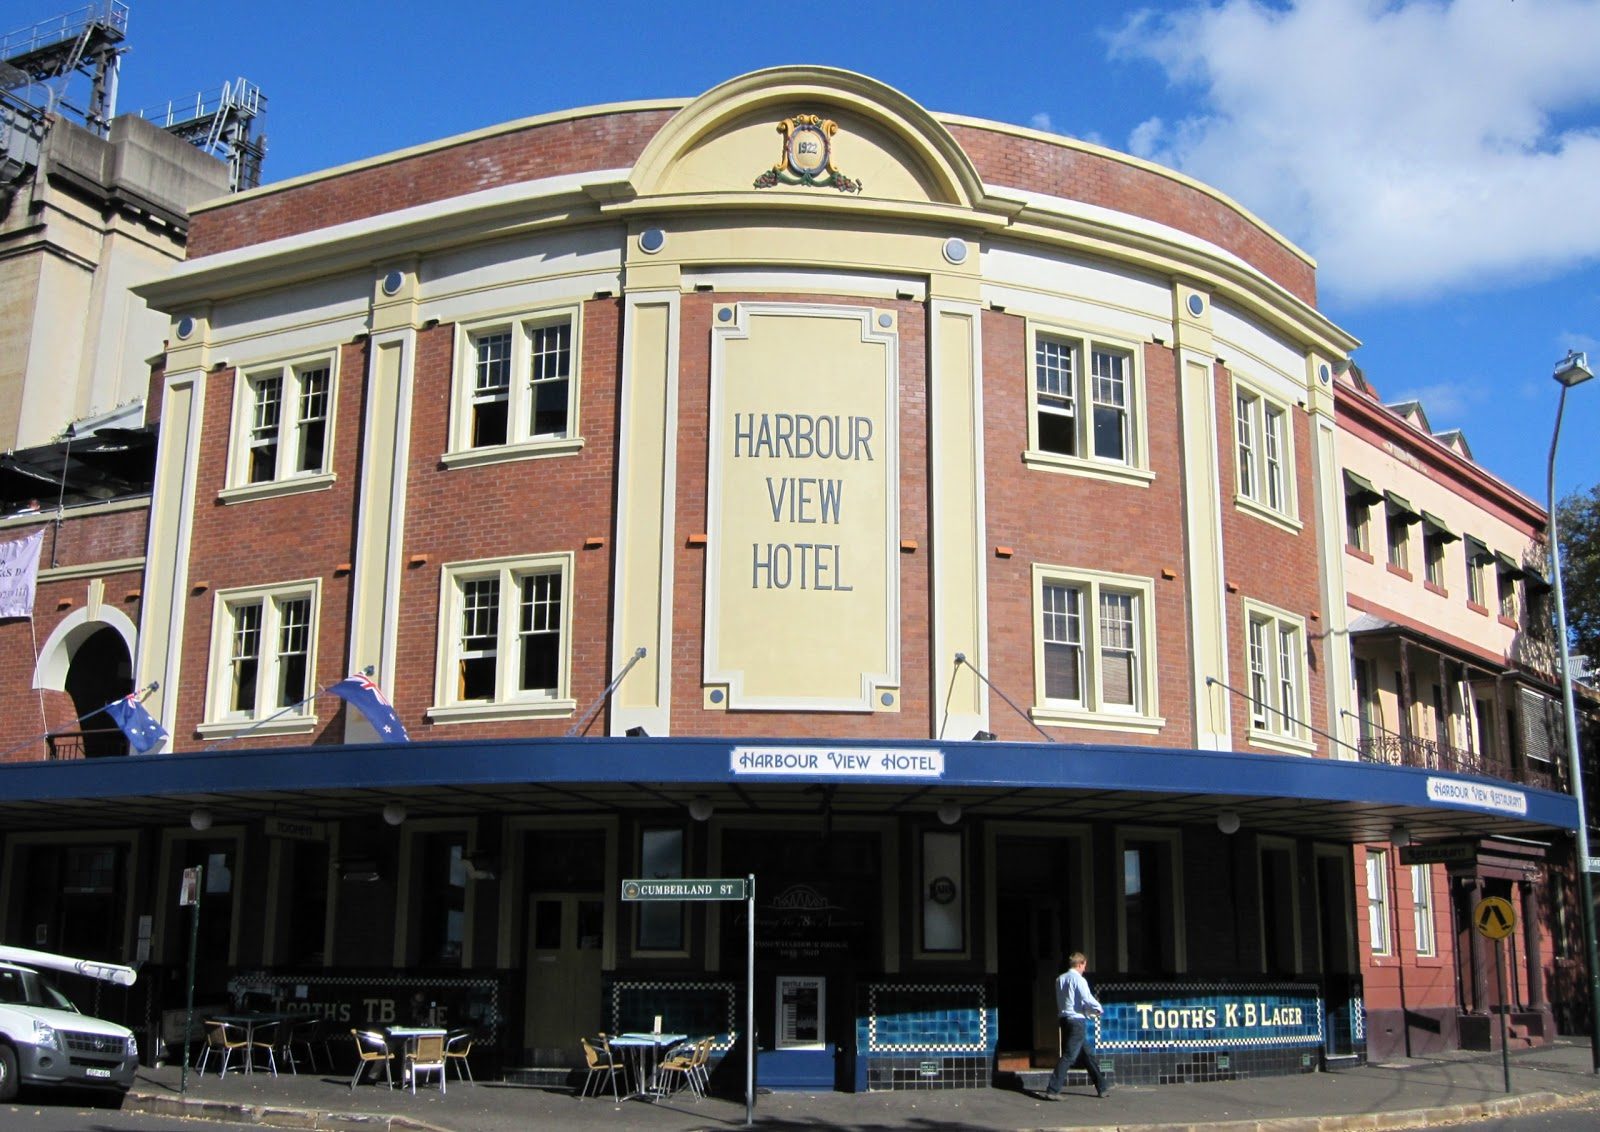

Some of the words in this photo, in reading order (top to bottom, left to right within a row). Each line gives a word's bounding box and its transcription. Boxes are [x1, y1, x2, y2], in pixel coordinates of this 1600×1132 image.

[799, 142, 817, 154] 1922
[735, 413, 874, 461] HARBOUR
[766, 477, 843, 525] VIEW
[752, 543, 853, 592] HOTEL
[739, 752, 818, 769] HARBOUR
[827, 752, 871, 770] VIEW
[881, 753, 936, 771] HOTEL
[1434, 782, 1469, 799] HARBOUR
[1471, 786, 1488, 801] VIEW
[1490, 789, 1522, 808] RESTAURANT
[641, 884, 712, 895] CUMBERLAND
[720, 884, 733, 895] ST
[363, 999, 395, 1023] TB
[1136, 1004, 1216, 1029] TOOTH'S
[1261, 1003, 1303, 1027] LAGER
